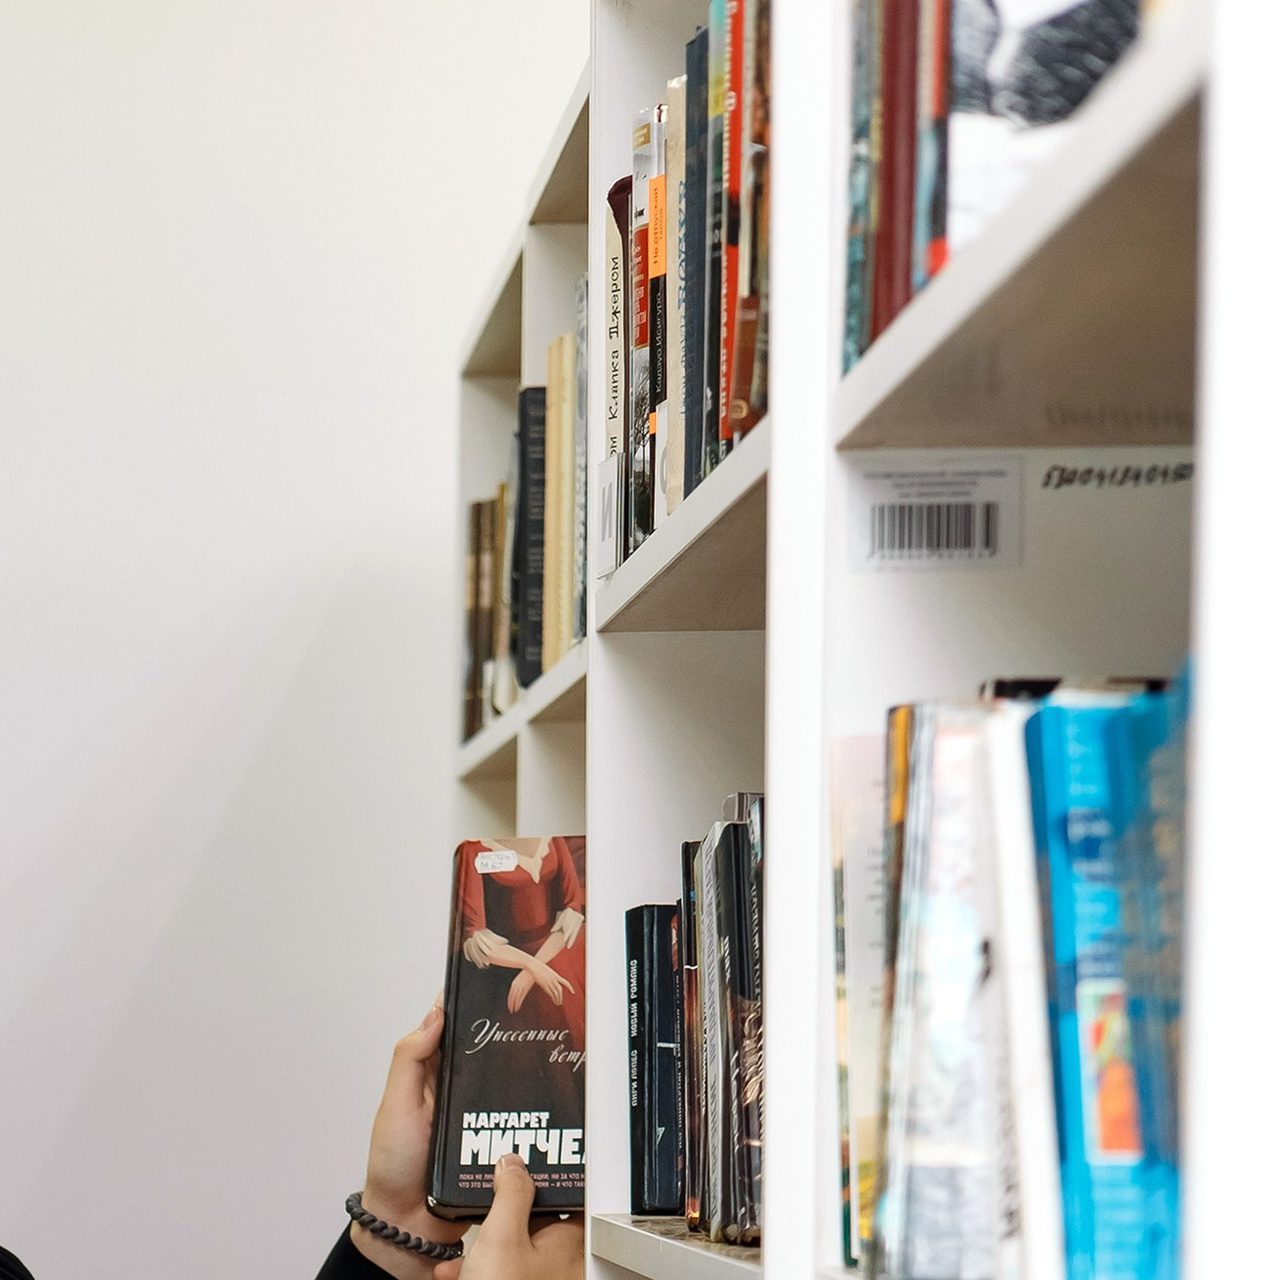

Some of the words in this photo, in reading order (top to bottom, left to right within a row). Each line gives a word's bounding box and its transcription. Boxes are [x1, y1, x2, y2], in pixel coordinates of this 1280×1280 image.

[608, 255, 622, 342] Джером
[464, 1017, 570, 1055] Унесенные
[462, 1111, 550, 1129] МАРГАРЕТ
